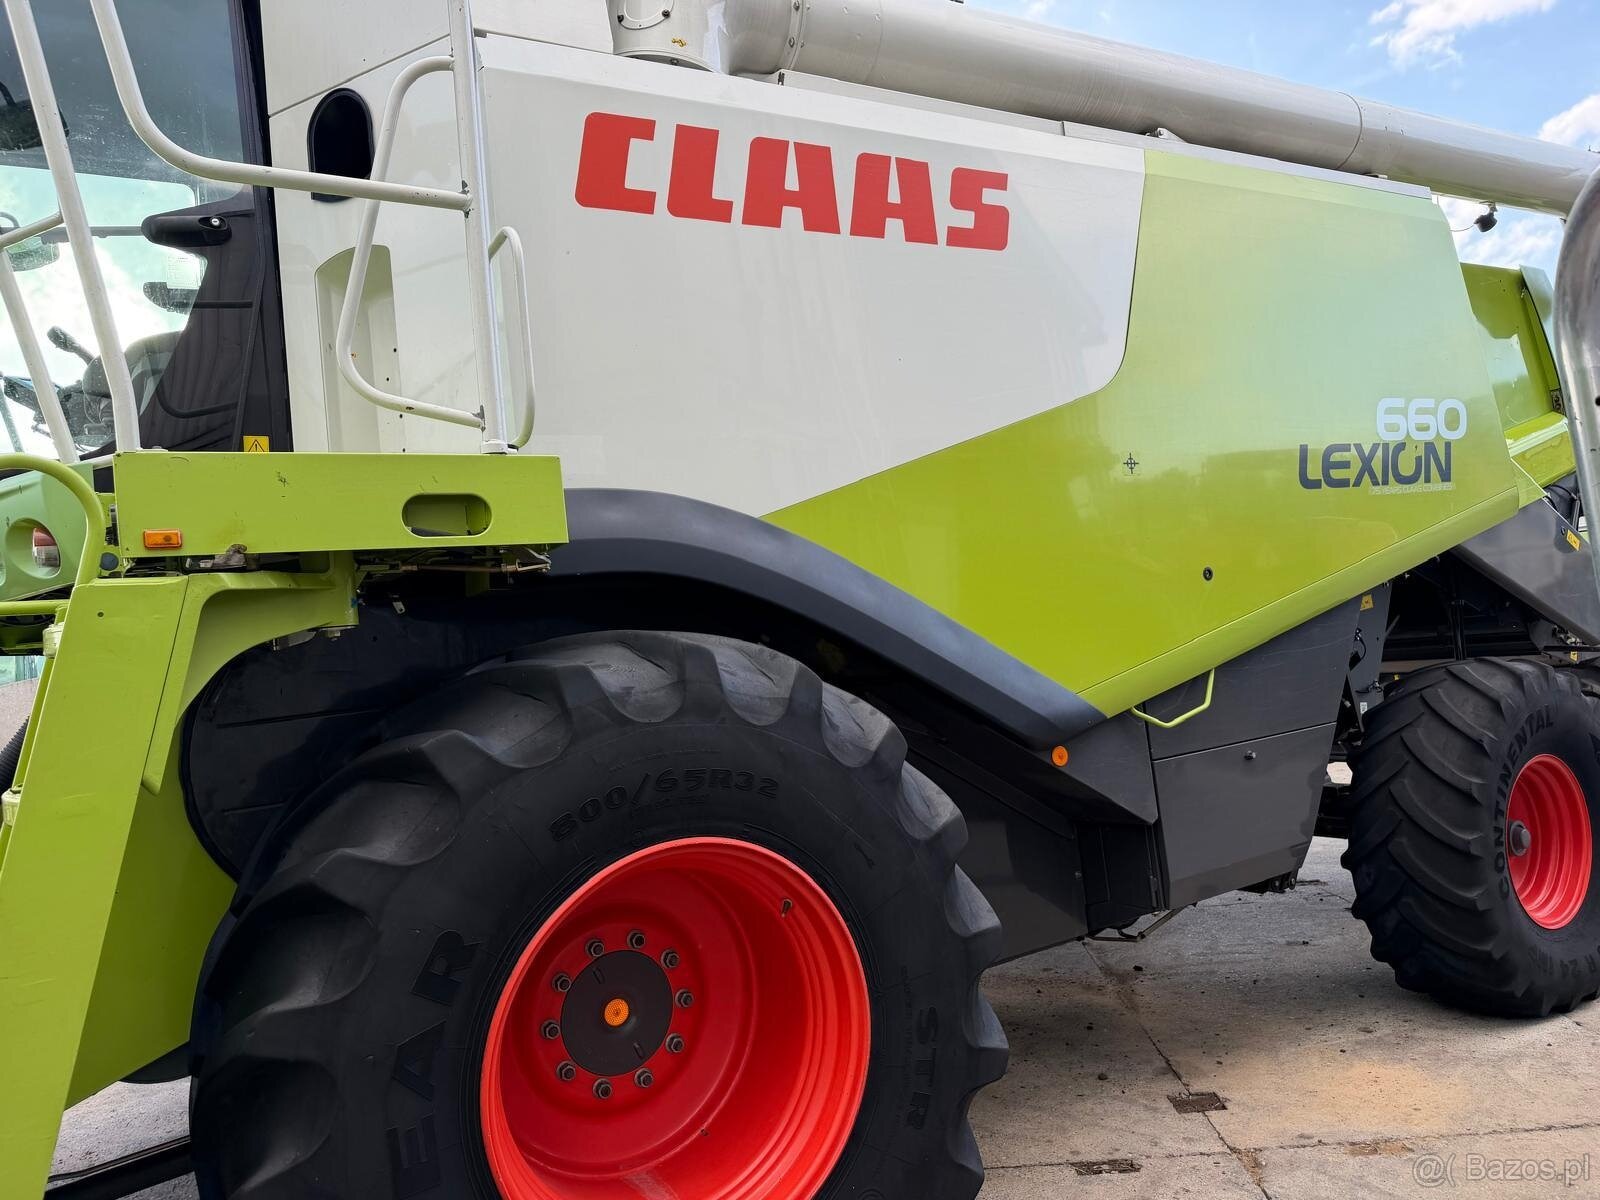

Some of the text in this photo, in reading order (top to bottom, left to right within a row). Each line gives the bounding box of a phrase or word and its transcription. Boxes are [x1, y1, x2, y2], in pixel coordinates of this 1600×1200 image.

[575, 112, 1009, 251] CLAAS
[1376, 397, 1467, 441] 660
[1298, 441, 1452, 489] LEXION
[549, 767, 780, 843] 800/65R32
[1493, 703, 1555, 899] CONTINENTAL
